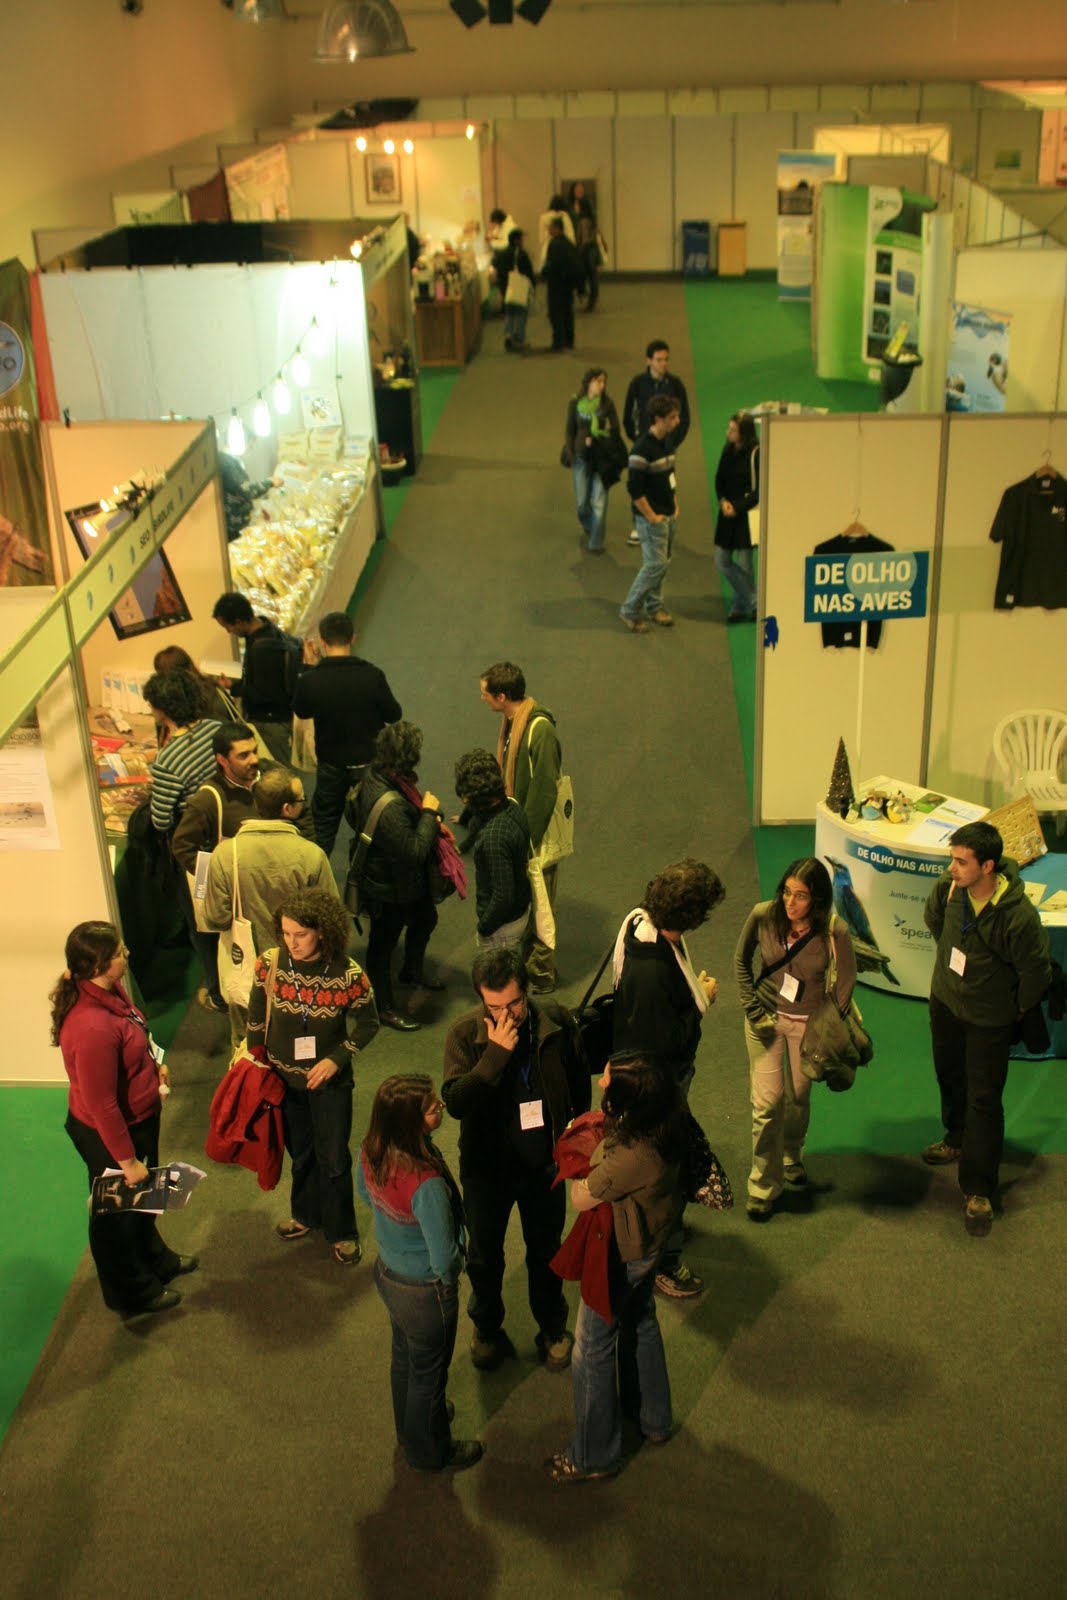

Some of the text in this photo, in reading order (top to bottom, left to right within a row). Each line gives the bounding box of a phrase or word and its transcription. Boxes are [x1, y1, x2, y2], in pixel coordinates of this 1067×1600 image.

[815, 560, 911, 585] DE OLHO
[813, 590, 912, 614] NAS AVES
[858, 848, 944, 874] DE OLHO NAS AVES
[900, 927, 932, 940] spea
